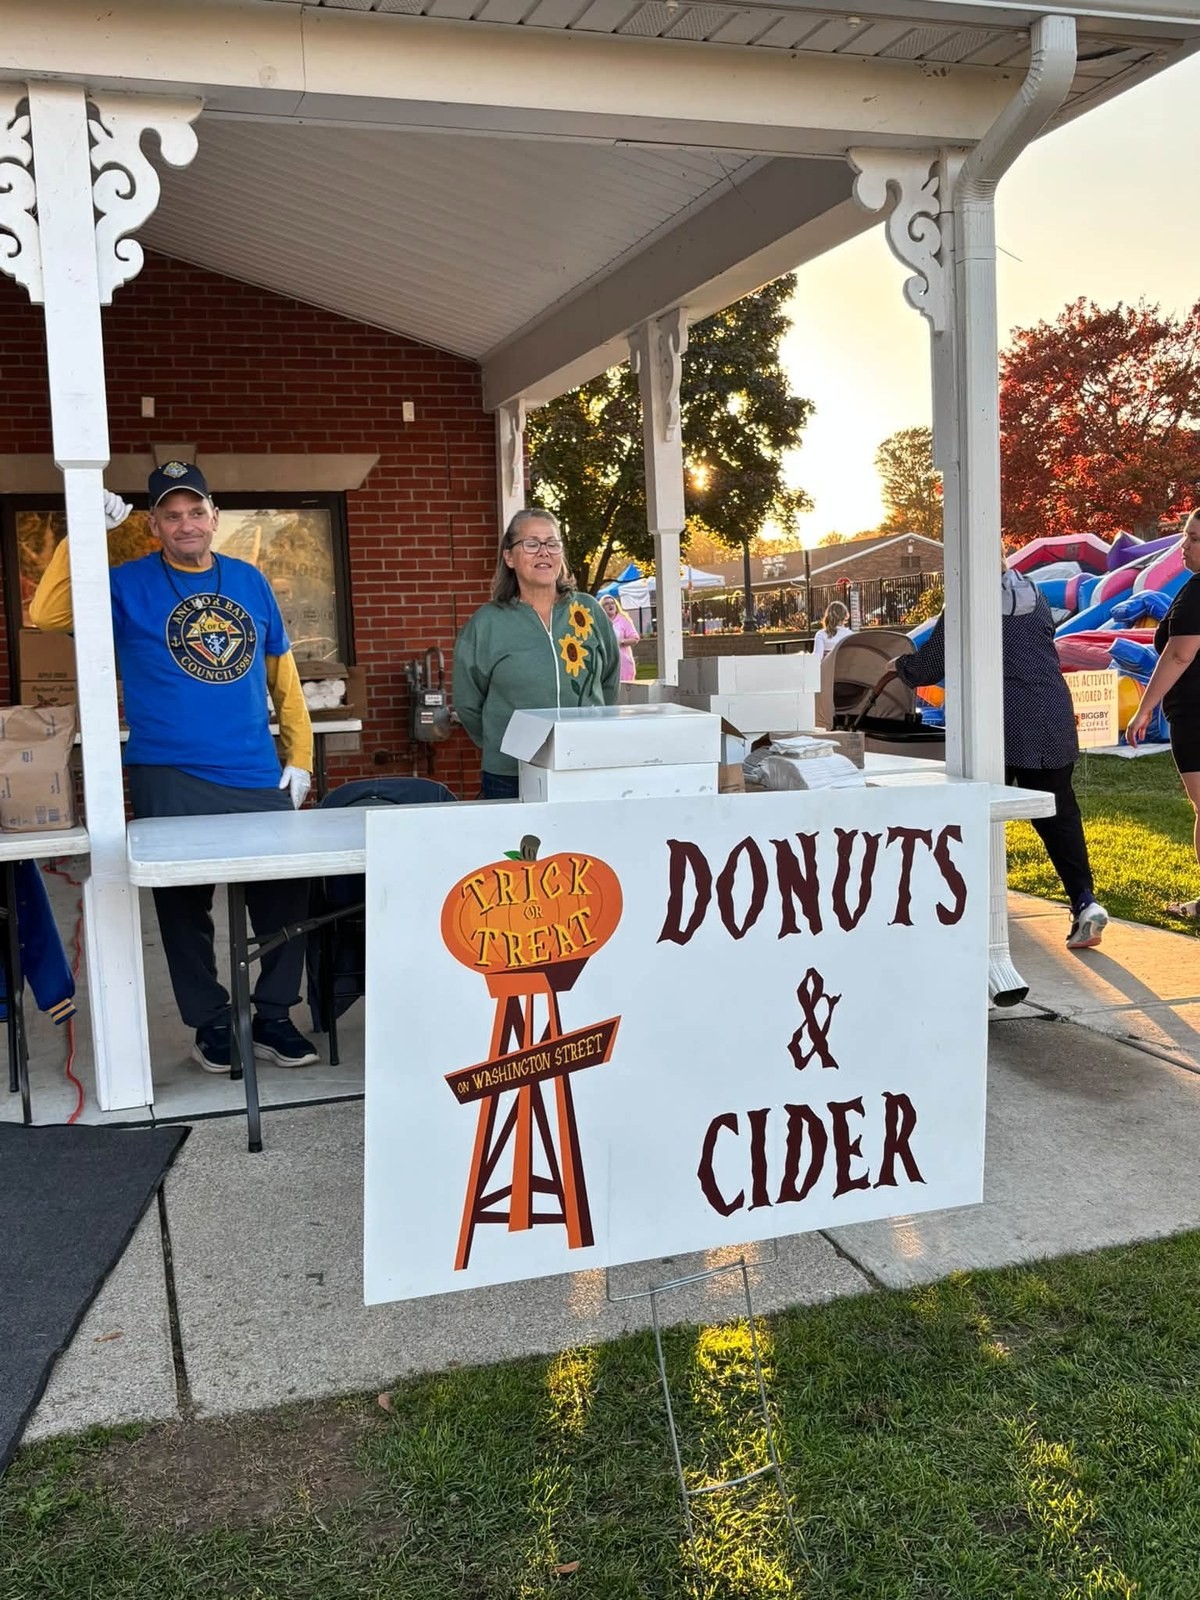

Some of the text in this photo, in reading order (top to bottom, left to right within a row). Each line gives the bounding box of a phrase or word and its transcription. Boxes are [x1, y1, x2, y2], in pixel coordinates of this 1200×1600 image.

[225, 601, 248, 621] BAY
[199, 623, 207, 632] K
[217, 622, 226, 630] C
[180, 653, 252, 680] COUNCIL 5981
[1081, 673, 1114, 687] ACTIVITY
[1072, 690, 1102, 702] ONSORED
[1081, 711, 1109, 720] BIGGBY
[461, 857, 595, 915] TRICK
[656, 825, 967, 946] DONUTS
[523, 905, 544, 920] OR
[471, 907, 598, 968] TREAT
[787, 967, 842, 1071] &
[457, 1033, 603, 1095] ON WASHINGTON STREET
[697, 1091, 928, 1217] CIDER
